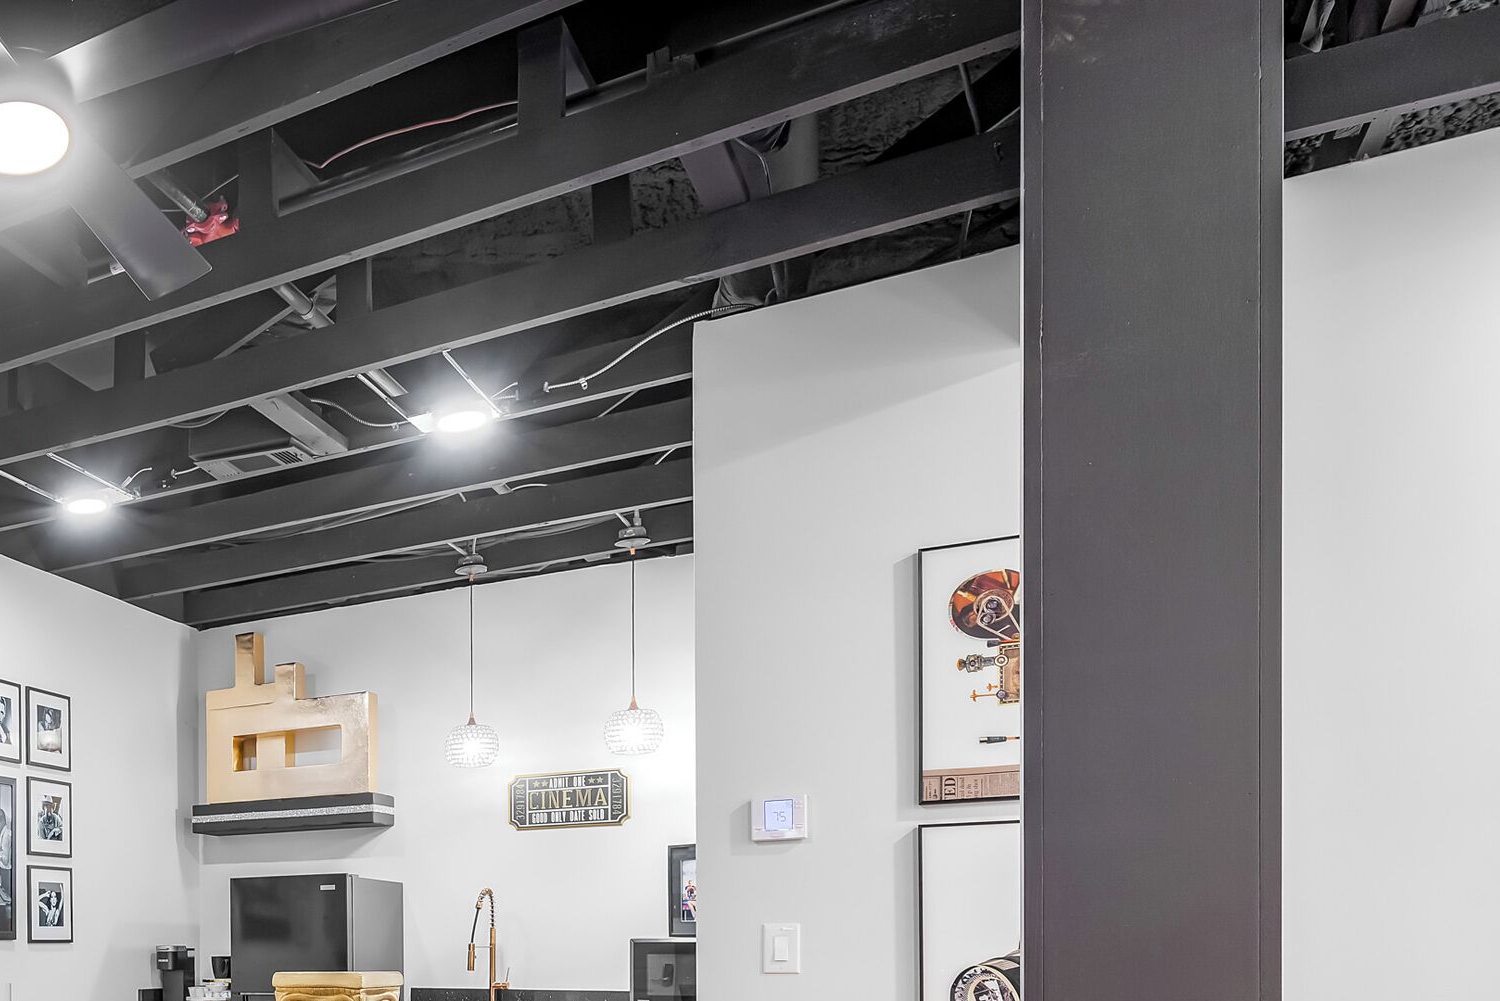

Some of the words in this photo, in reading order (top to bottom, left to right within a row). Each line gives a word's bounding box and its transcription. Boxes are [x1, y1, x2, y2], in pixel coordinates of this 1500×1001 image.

[548, 777, 569, 789] ADMIT
[573, 775, 586, 787] ONE
[515, 783, 525, 820] 3291784
[529, 787, 608, 810] CINEMA
[531, 812, 548, 824] GOOD
[550, 811, 567, 823] ONLY
[569, 809, 586, 822] DATE
[588, 808, 605, 821] SOLD
[772, 811, 787, 823] 75
